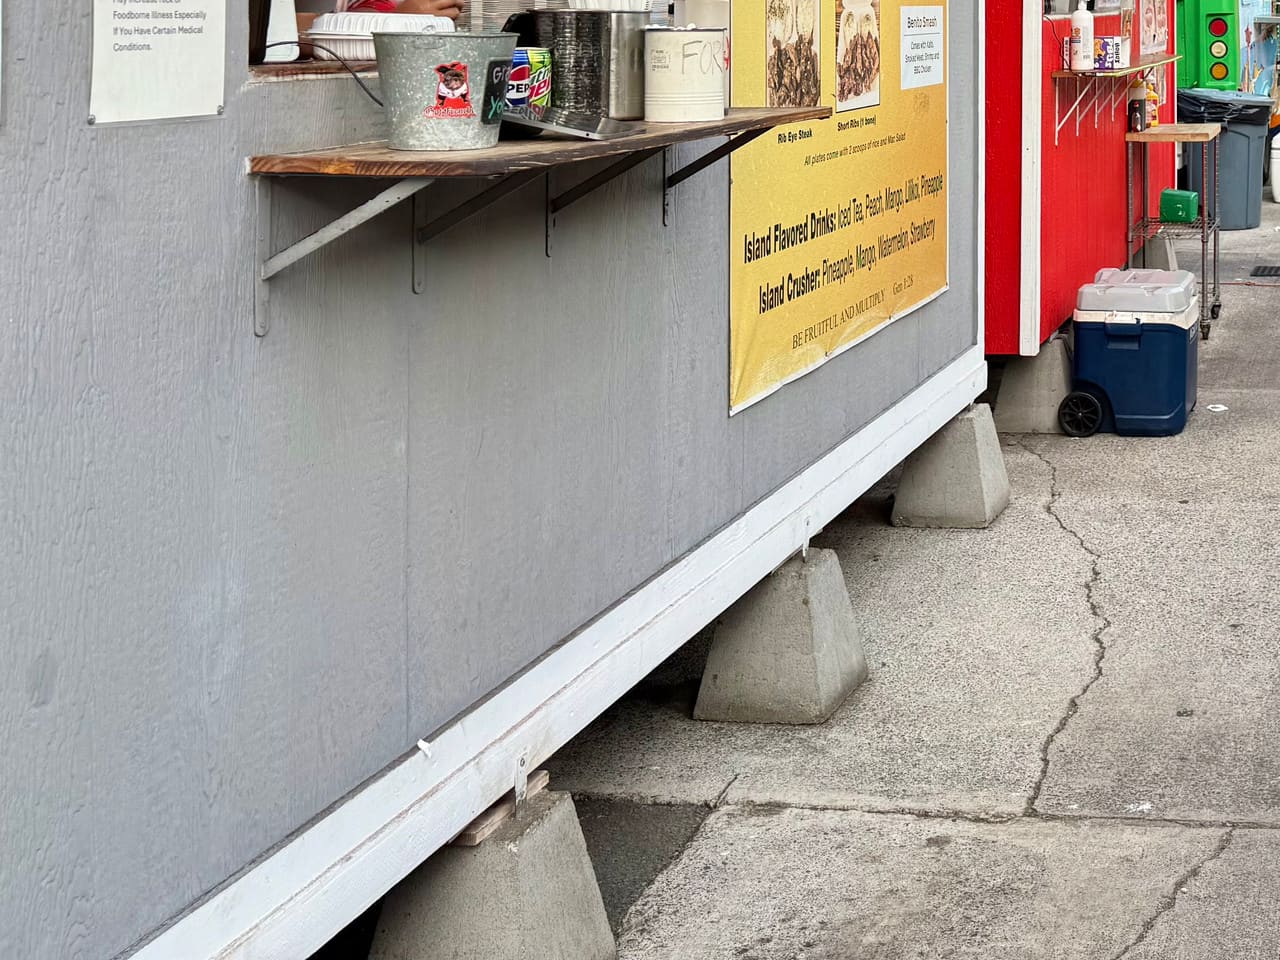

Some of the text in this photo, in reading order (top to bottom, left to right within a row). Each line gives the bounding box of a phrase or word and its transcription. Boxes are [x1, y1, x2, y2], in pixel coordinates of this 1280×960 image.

[112, 10, 207, 20] Foodborne Illness Especially
[120, 26, 132, 35] You
[134, 26, 151, 35] Have
[152, 25, 176, 35] Certain
[178, 25, 204, 34] Medical
[777, 128, 813, 144] Rib Eye Steak
[837, 121, 849, 132] Short
[850, 119, 859, 128] Ribs
[812, 153, 826, 166] plates
[826, 150, 839, 160] come
[840, 148, 849, 157] with
[852, 142, 867, 154] scoops
[872, 138, 880, 148] rice
[744, 226, 771, 264] Island
[774, 215, 808, 253] Flavored
[811, 208, 837, 238] Drinks:
[837, 201, 851, 231] Iced
[852, 198, 864, 225] Tea,
[865, 192, 883, 220] Peach,
[884, 186, 904, 214] Mango,
[921, 170, 943, 198] Pineapple
[759, 217, 936, 314] Island Crusher: Pineapple, Mango, Watermelon, Strawberry
[792, 331, 803, 349] BE
[804, 315, 839, 343] FRUITFUL
[839, 307, 855, 326] AND
[855, 288, 885, 315] MULTIPLY
